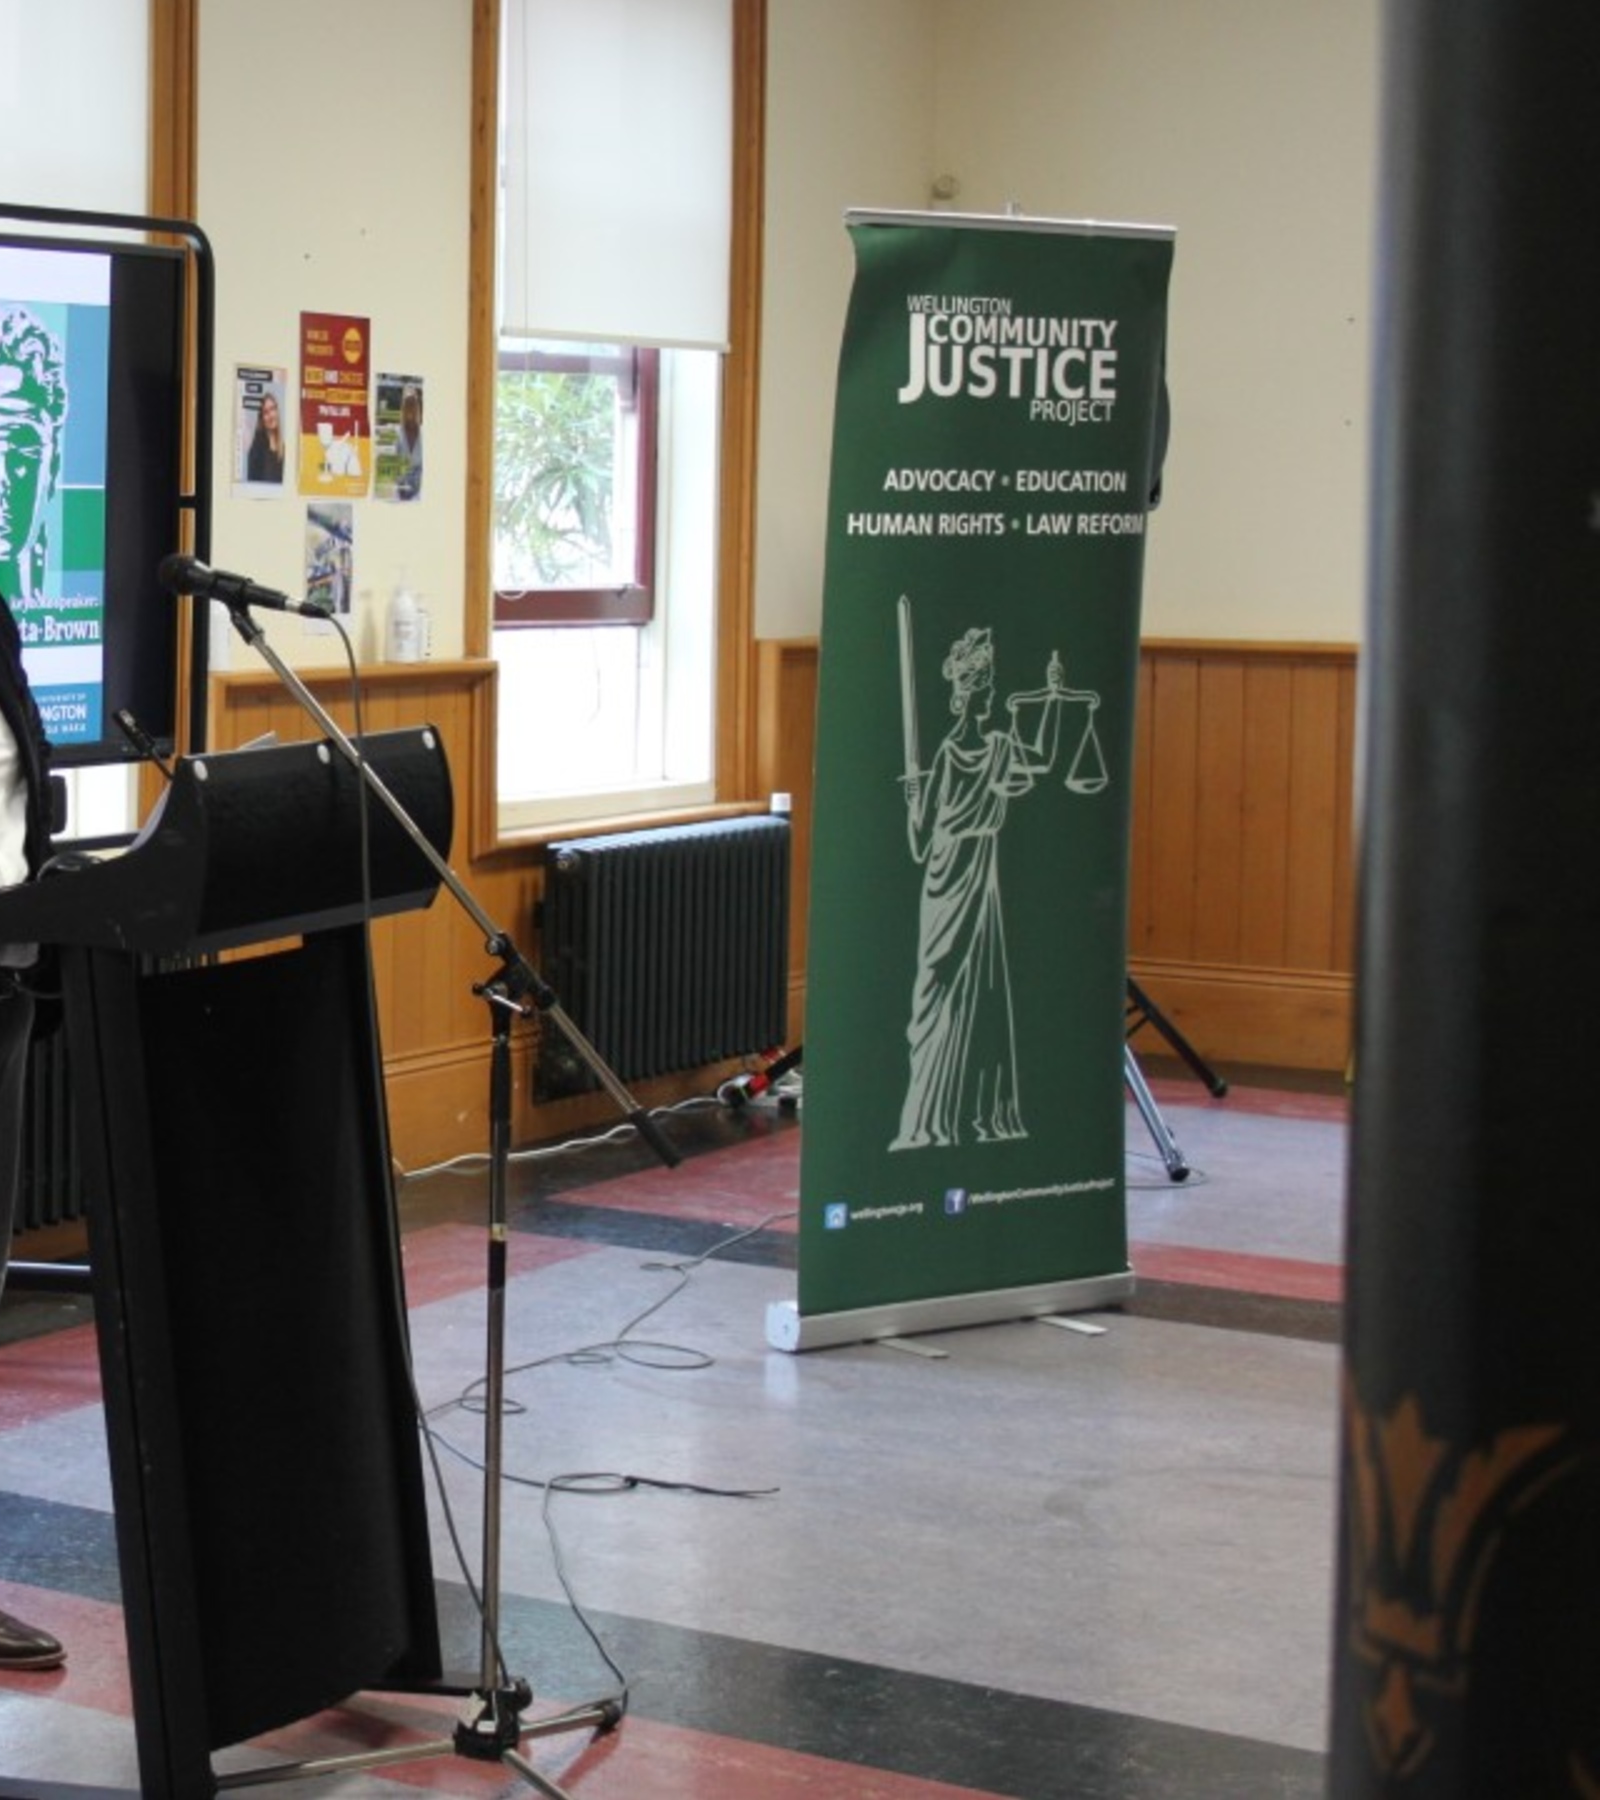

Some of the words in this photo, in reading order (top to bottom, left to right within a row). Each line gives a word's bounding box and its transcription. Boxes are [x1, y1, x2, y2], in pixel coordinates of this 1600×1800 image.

[907, 296, 1012, 316] WELLINGTON
[928, 314, 1118, 349] COMMUNITY
[898, 313, 1118, 404] JUSTICE
[1030, 400, 1115, 426] PROJECT
[884, 469, 995, 491] ADVOCACY
[1016, 471, 1127, 493] EDUCATION
[847, 513, 933, 534] HUMAN
[938, 514, 1006, 534] RIGHTS
[1026, 514, 1071, 535] LAW
[1077, 514, 1144, 535] REFORM
